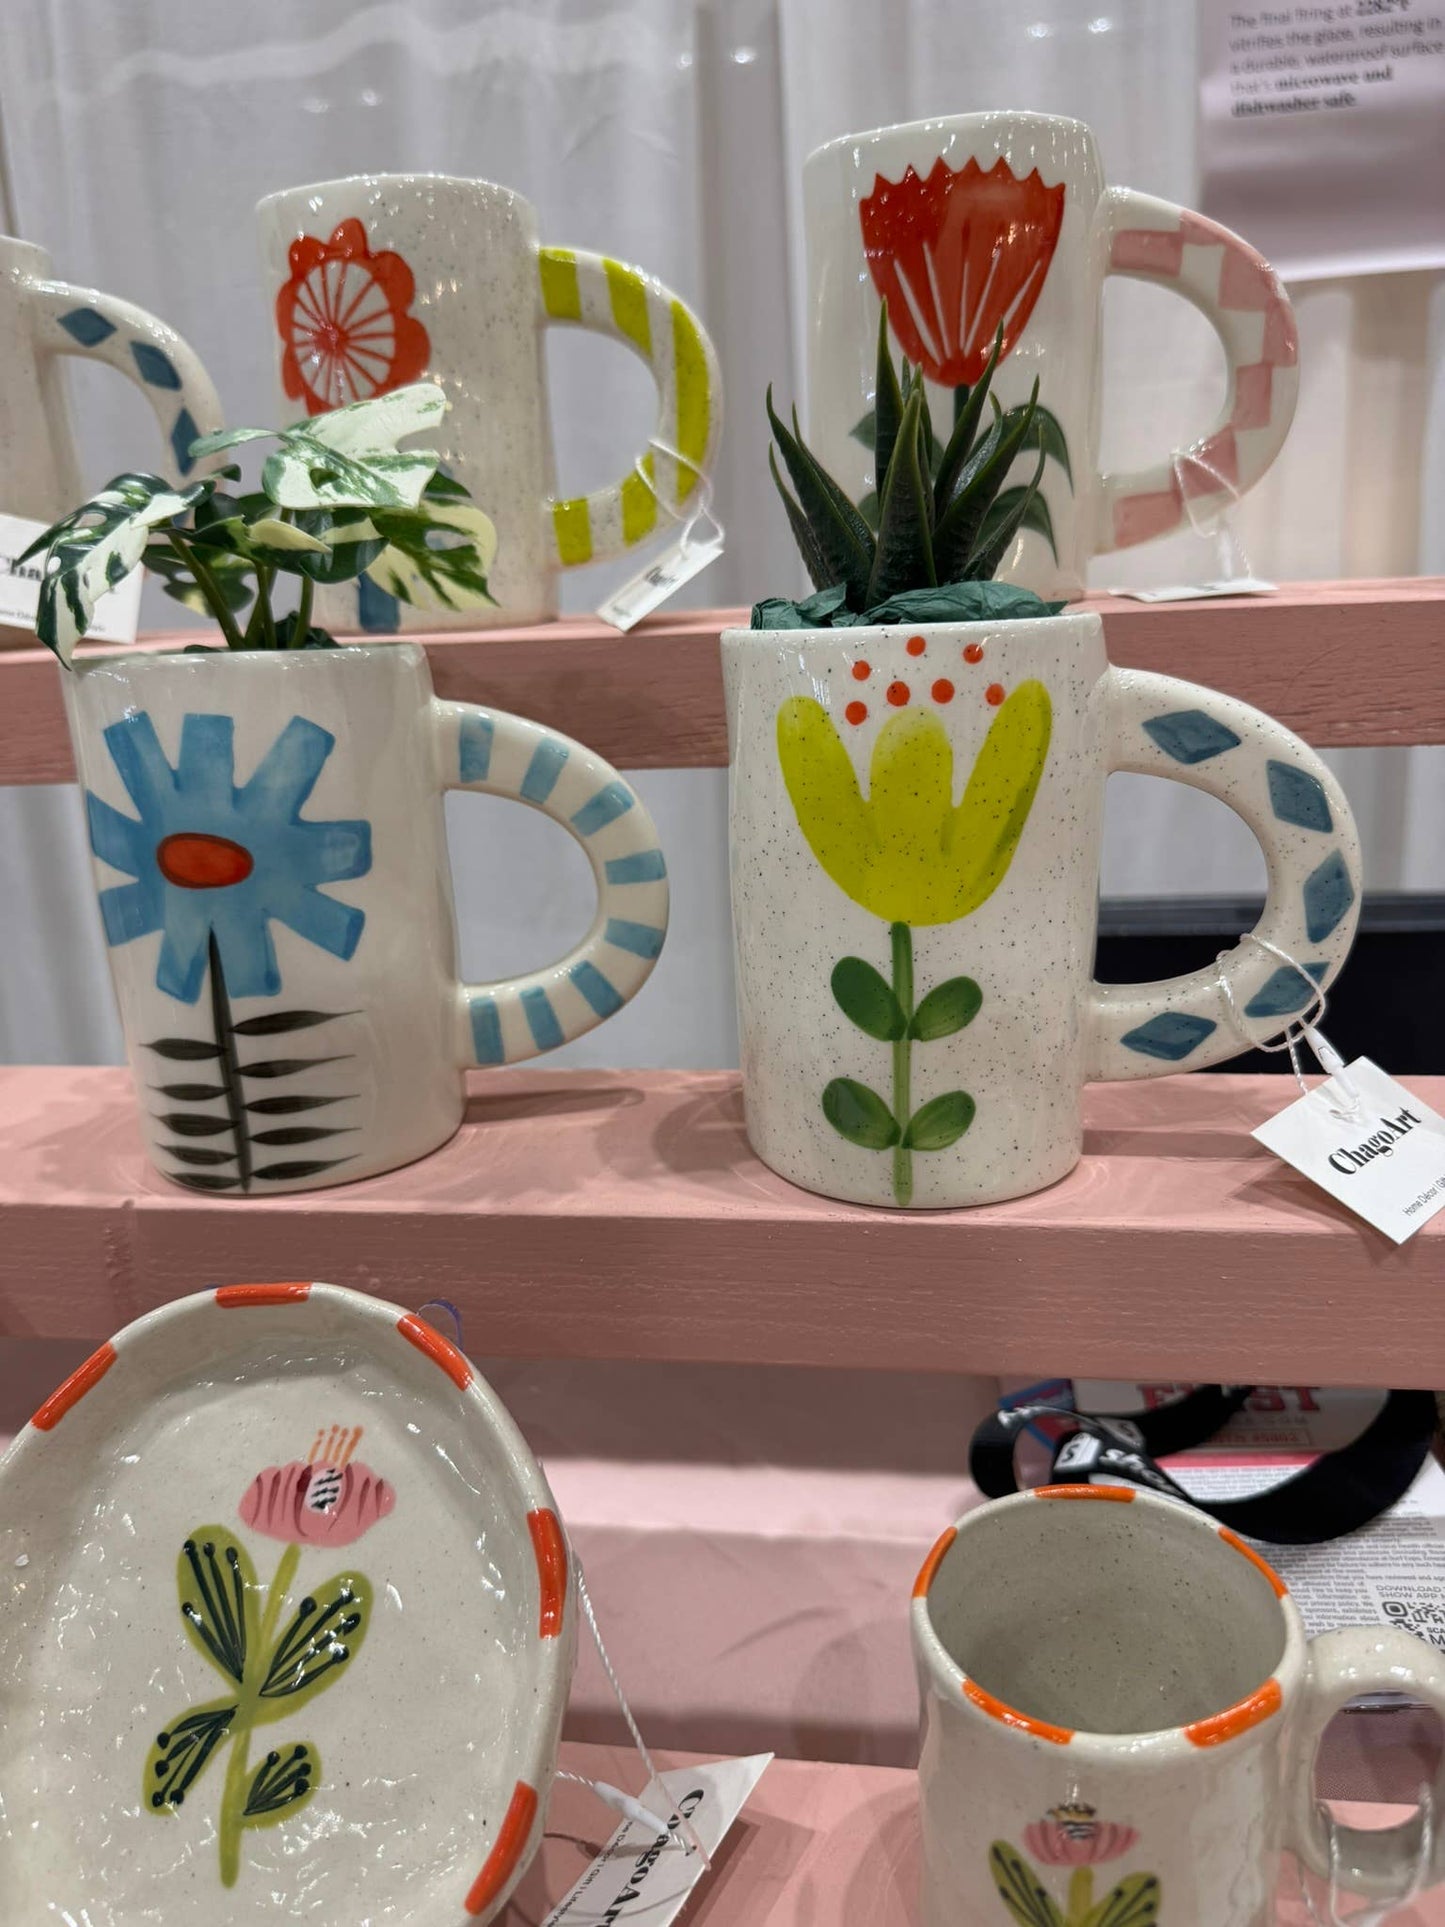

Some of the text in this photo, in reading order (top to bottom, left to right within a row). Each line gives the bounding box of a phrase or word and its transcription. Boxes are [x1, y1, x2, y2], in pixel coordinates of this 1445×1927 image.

[1275, 70, 1360, 91] microwave
[1363, 65, 1394, 83] and
[1232, 96, 1320, 117] dishwasher
[1327, 1106, 1422, 1175] ChagoArt
[1402, 1199, 1424, 1217] Home
[1375, 1584, 1442, 1592] DOWNLOAD
